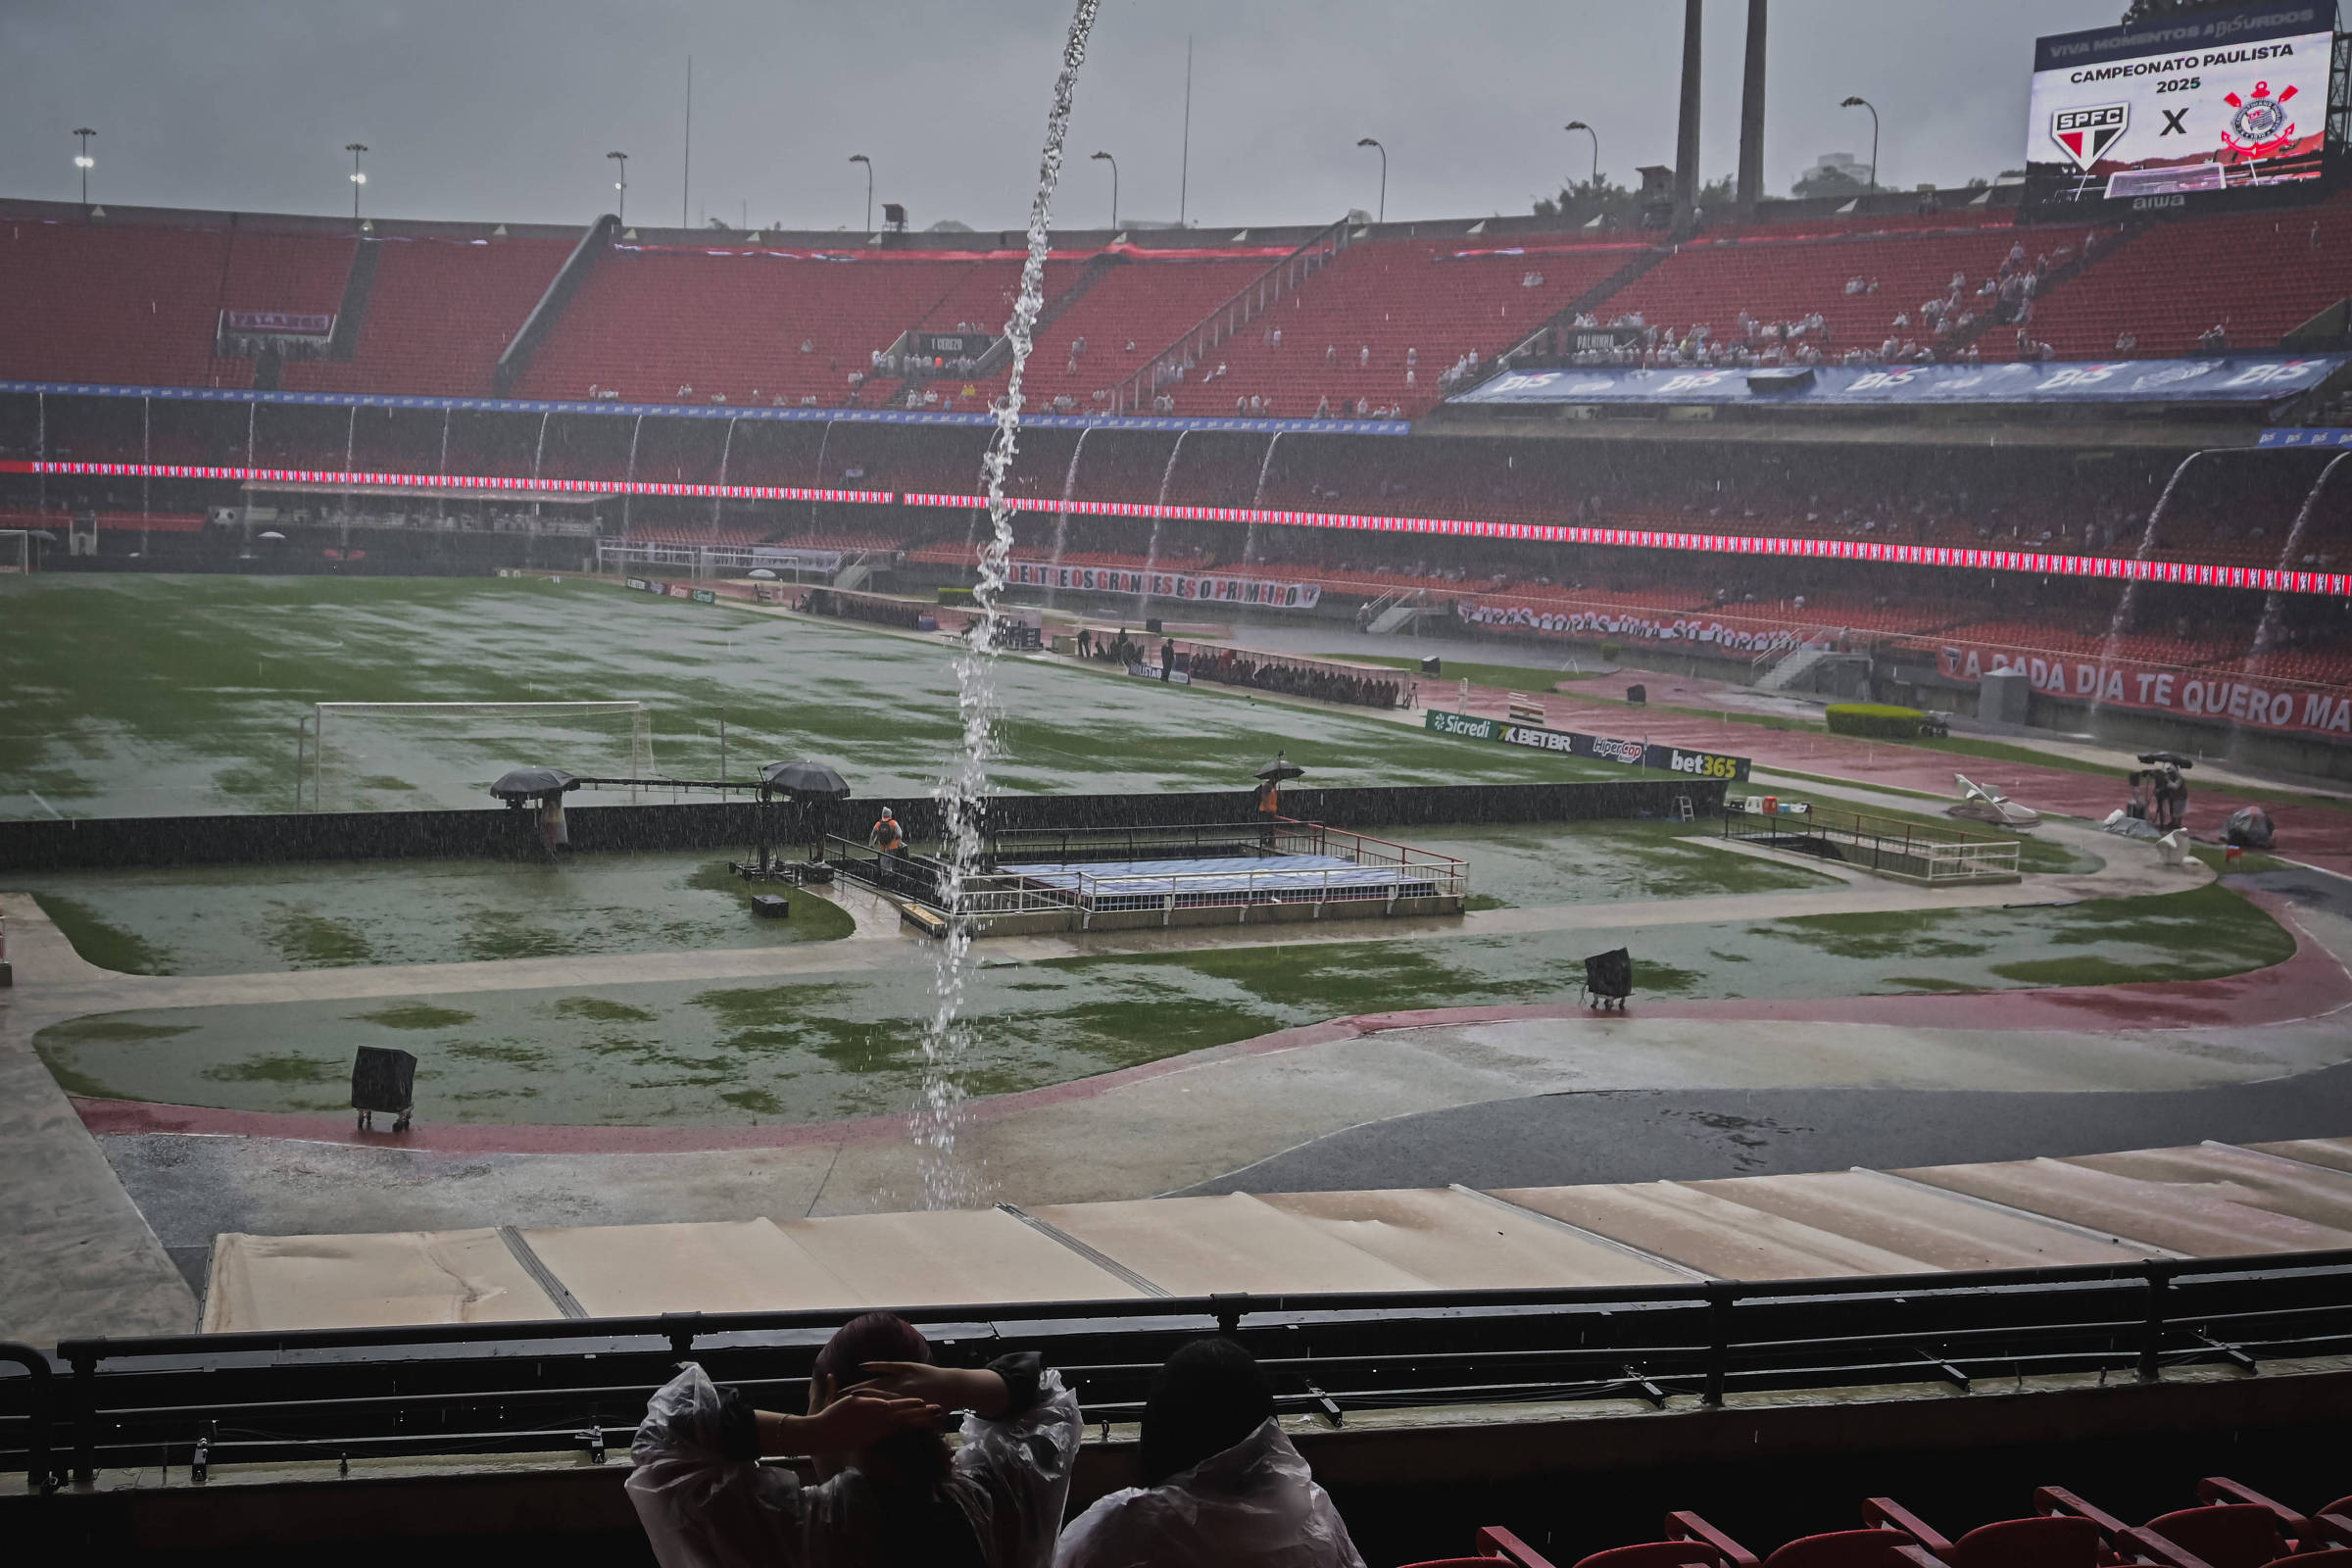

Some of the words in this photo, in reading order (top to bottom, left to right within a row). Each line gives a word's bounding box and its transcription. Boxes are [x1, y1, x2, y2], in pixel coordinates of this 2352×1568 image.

[2049, 43, 2089, 59] VIVA
[2092, 25, 2200, 51] MOMENTOS
[2070, 56, 2199, 84] CAMPEONATO
[2203, 43, 2293, 67] PAULISTA
[2156, 76, 2201, 94] 2025
[2058, 107, 2123, 128] SPFC
[2160, 107, 2189, 136] X
[2132, 195, 2184, 210] aiwa
[1071, 569, 1094, 588] OS
[1097, 570, 1173, 595] GRANDES
[1200, 579, 1211, 599] O
[1214, 580, 1298, 606] PRIMEIRO
[1963, 651, 1982, 679] A
[1991, 654, 2066, 693] CADA
[2077, 664, 2125, 701] DIA
[2136, 673, 2175, 706] TE
[2182, 681, 2293, 725] QUERO
[2302, 694, 2352, 732] MA
[1445, 714, 1491, 738] Sicredi
[1671, 749, 1737, 778] bet365
